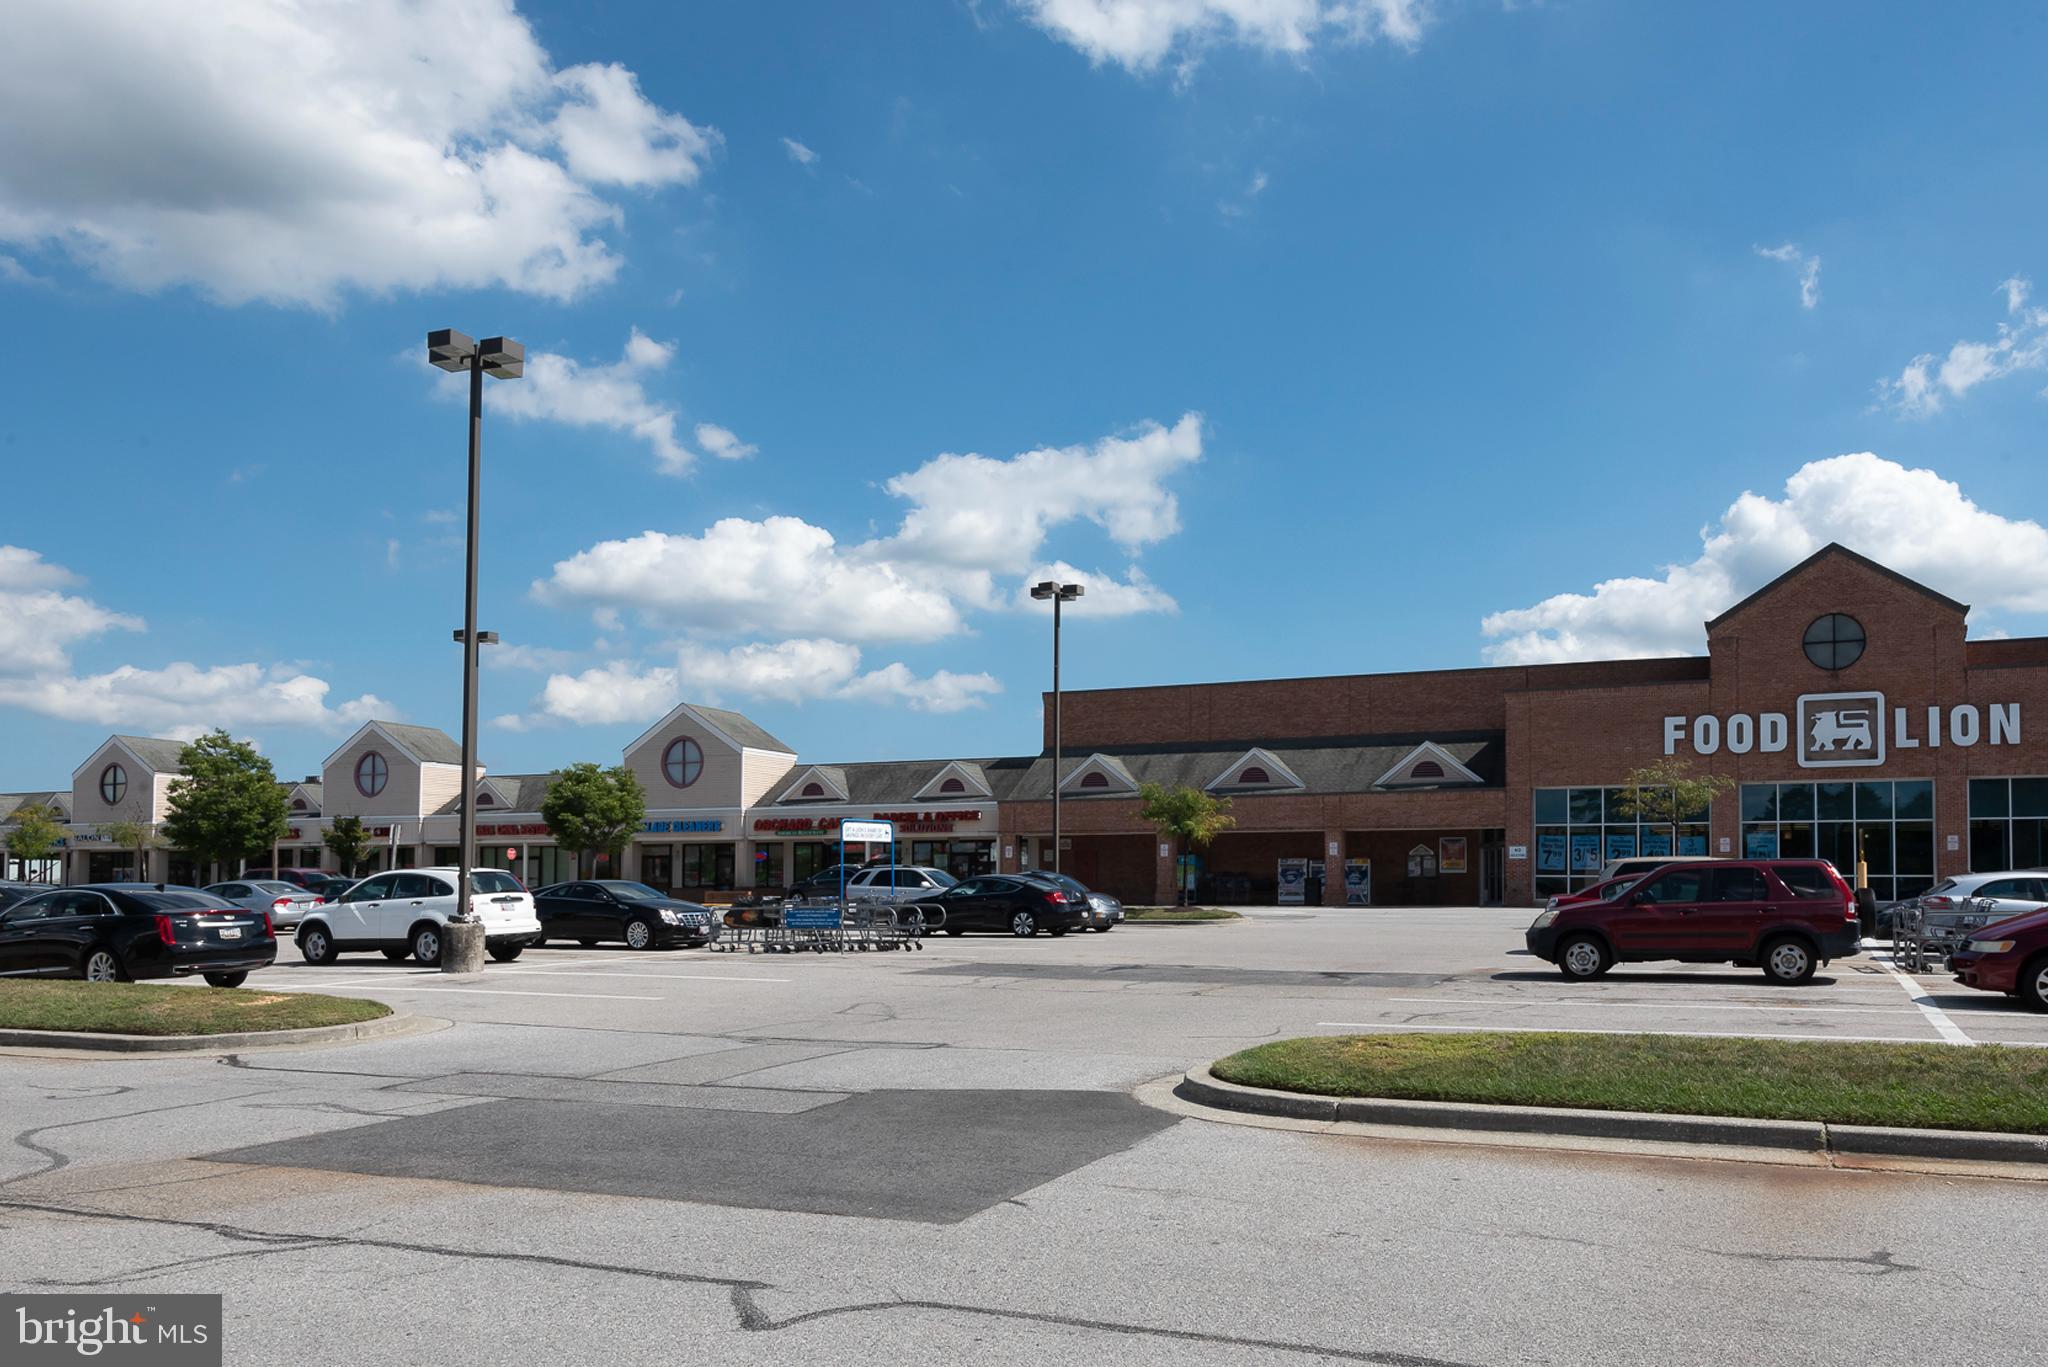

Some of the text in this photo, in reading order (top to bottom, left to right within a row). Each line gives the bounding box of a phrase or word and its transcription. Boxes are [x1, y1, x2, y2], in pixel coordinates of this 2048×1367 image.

[1664, 703, 2021, 755] FOOD LION
[754, 818, 812, 831] ORCHARD
